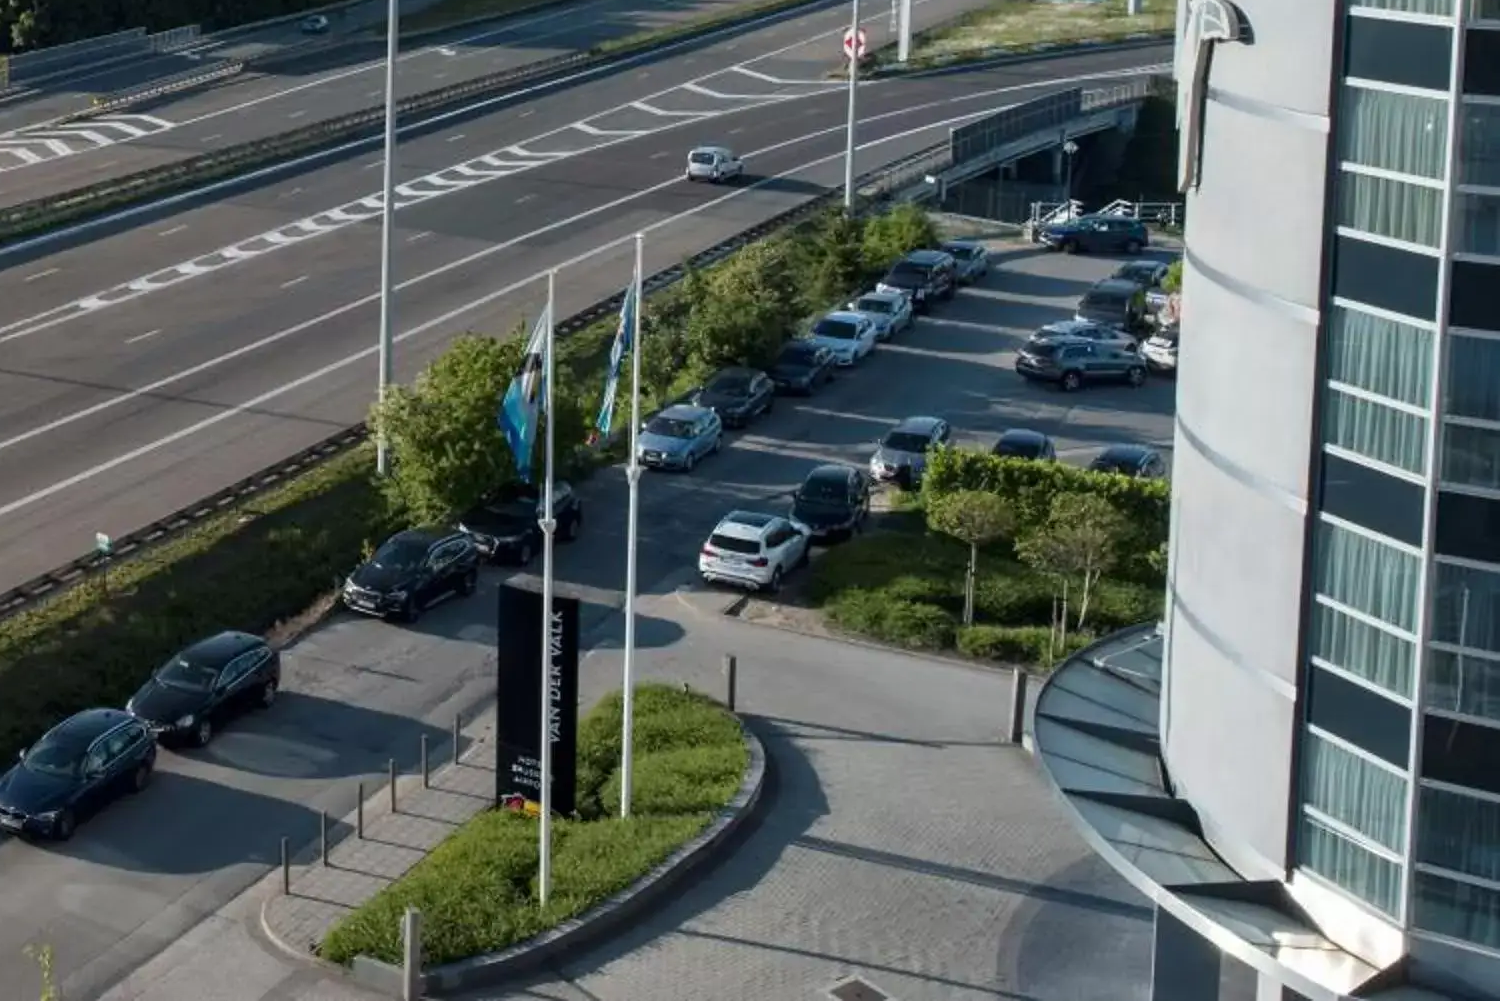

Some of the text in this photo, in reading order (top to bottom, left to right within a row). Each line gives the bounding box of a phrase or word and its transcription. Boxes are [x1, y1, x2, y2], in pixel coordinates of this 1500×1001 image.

[548, 610, 564, 744] VAN DER VALK
